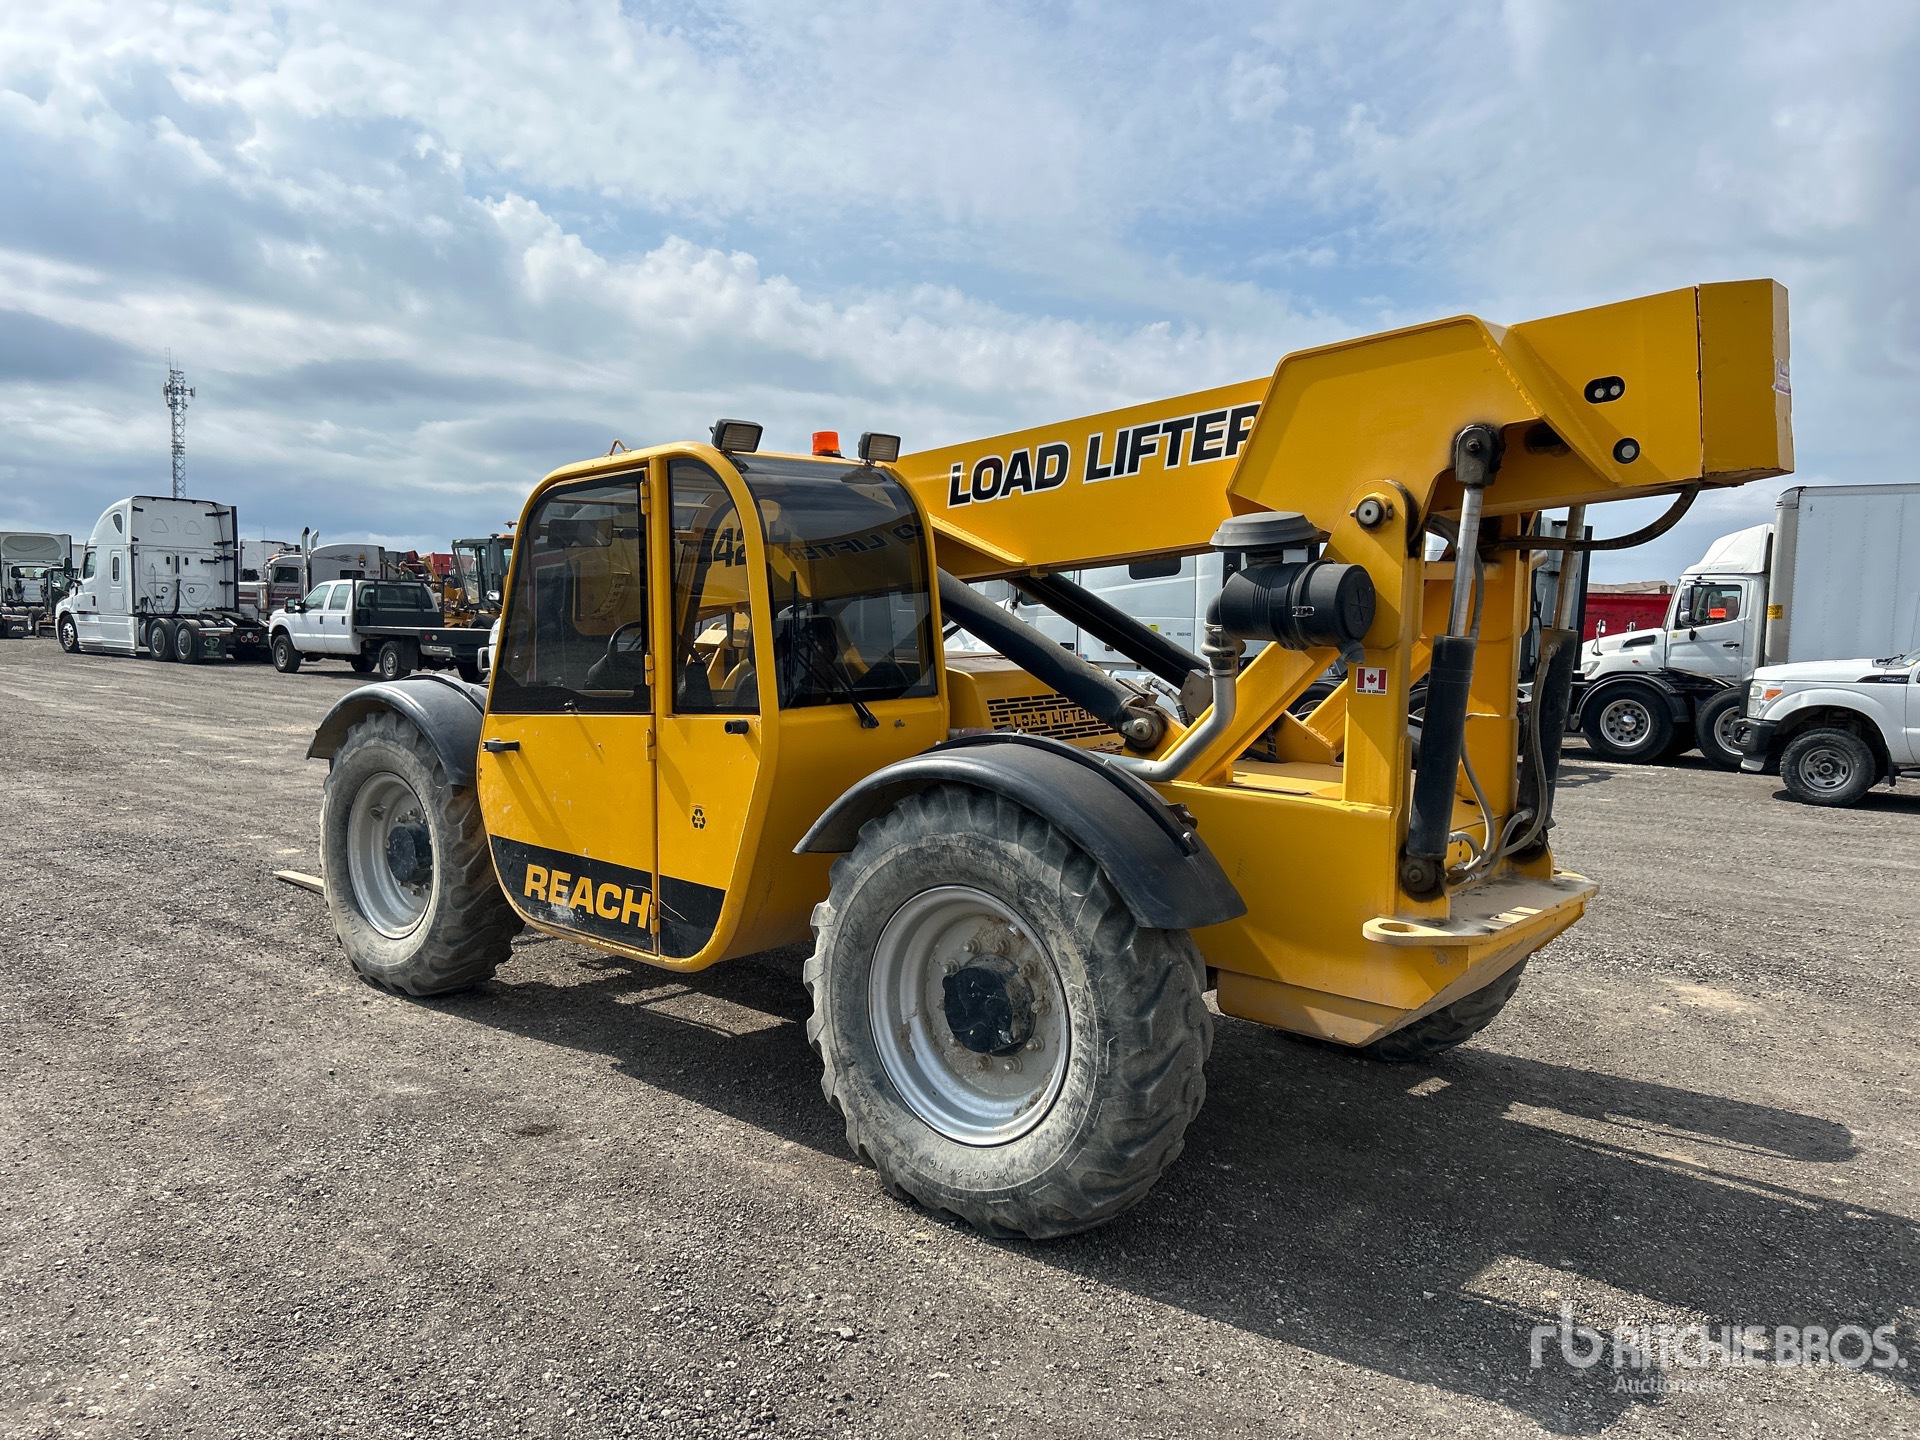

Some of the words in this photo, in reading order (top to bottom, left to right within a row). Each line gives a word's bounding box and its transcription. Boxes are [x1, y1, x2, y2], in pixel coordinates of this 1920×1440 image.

[947, 440, 1070, 509] LOAD
[1083, 400, 1262, 484] LIFTER
[1013, 712, 1047, 728] LOAD
[524, 863, 651, 929] REACH
